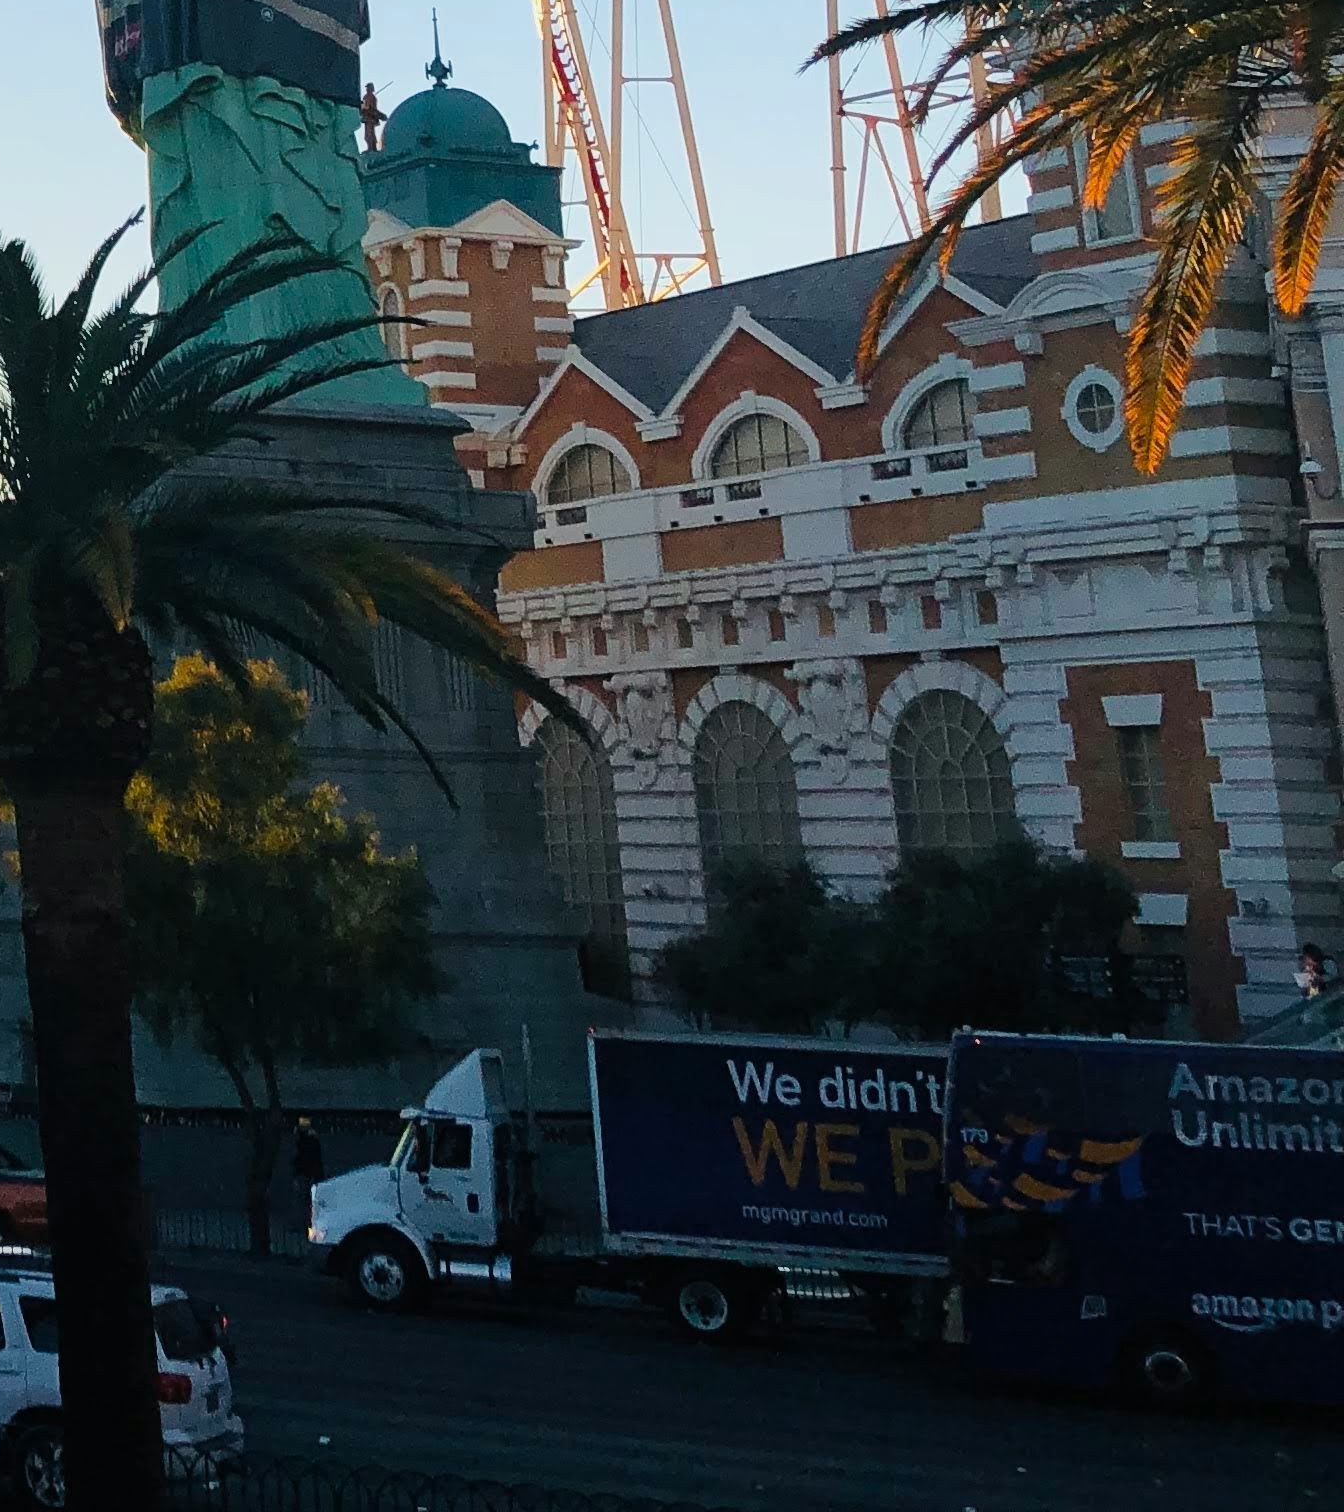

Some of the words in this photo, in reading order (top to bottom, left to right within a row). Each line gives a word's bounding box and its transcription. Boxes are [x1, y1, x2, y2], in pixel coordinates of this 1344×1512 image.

[726, 1059, 802, 1106] We
[818, 1066, 944, 1115] didn't
[1171, 1108, 1344, 1153] Unlimit
[732, 1116, 865, 1193] WE
[887, 1126, 943, 1195] P
[742, 1203, 888, 1229] mgmgrand.com
[1182, 1212, 1285, 1241] THAT'S
[1190, 1292, 1315, 1324] amazon
